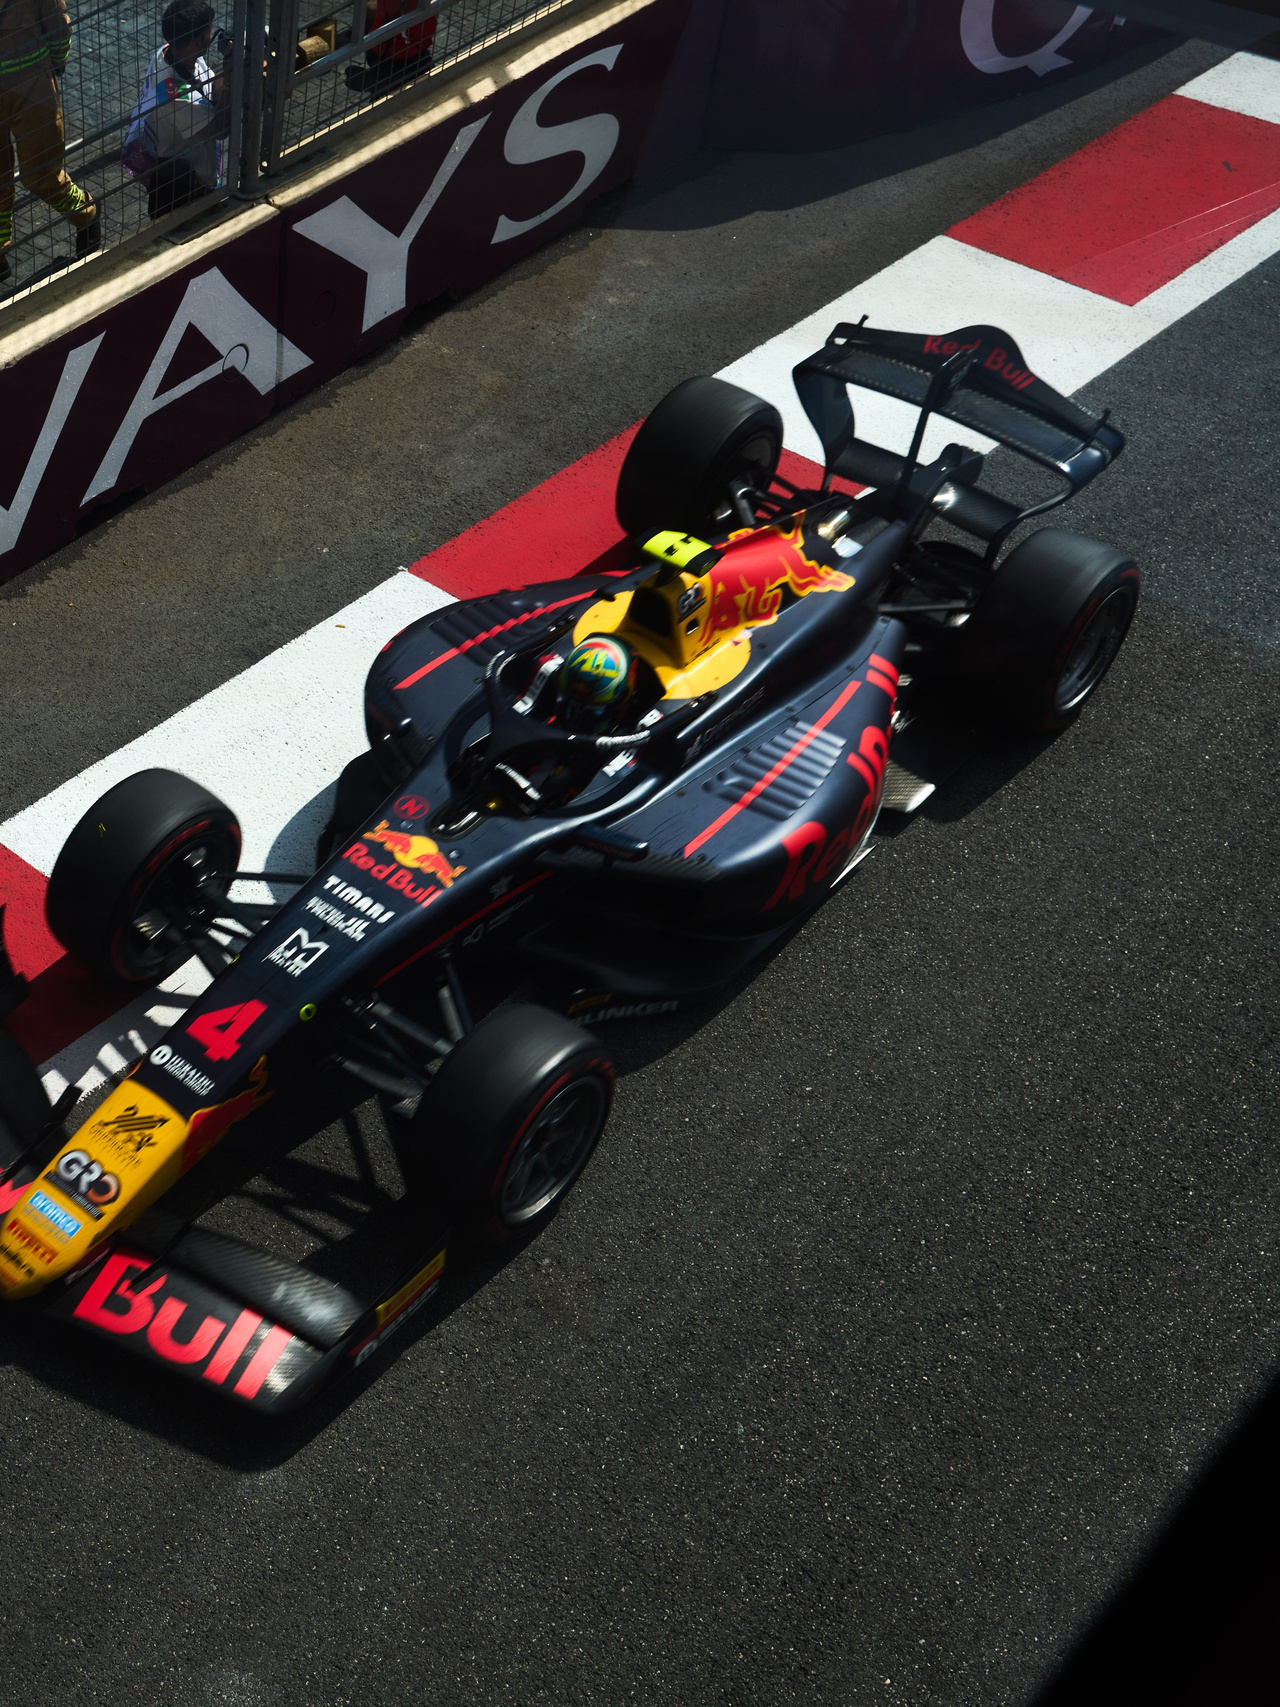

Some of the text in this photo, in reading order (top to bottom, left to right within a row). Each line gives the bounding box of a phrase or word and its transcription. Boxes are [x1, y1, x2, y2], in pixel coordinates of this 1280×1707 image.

[983, 346, 1038, 390] Bull
[857, 653, 900, 800] Bll
[341, 841, 444, 909] Red Bull
[185, 998, 269, 1063] 4
[72, 1252, 294, 1401] Bull
